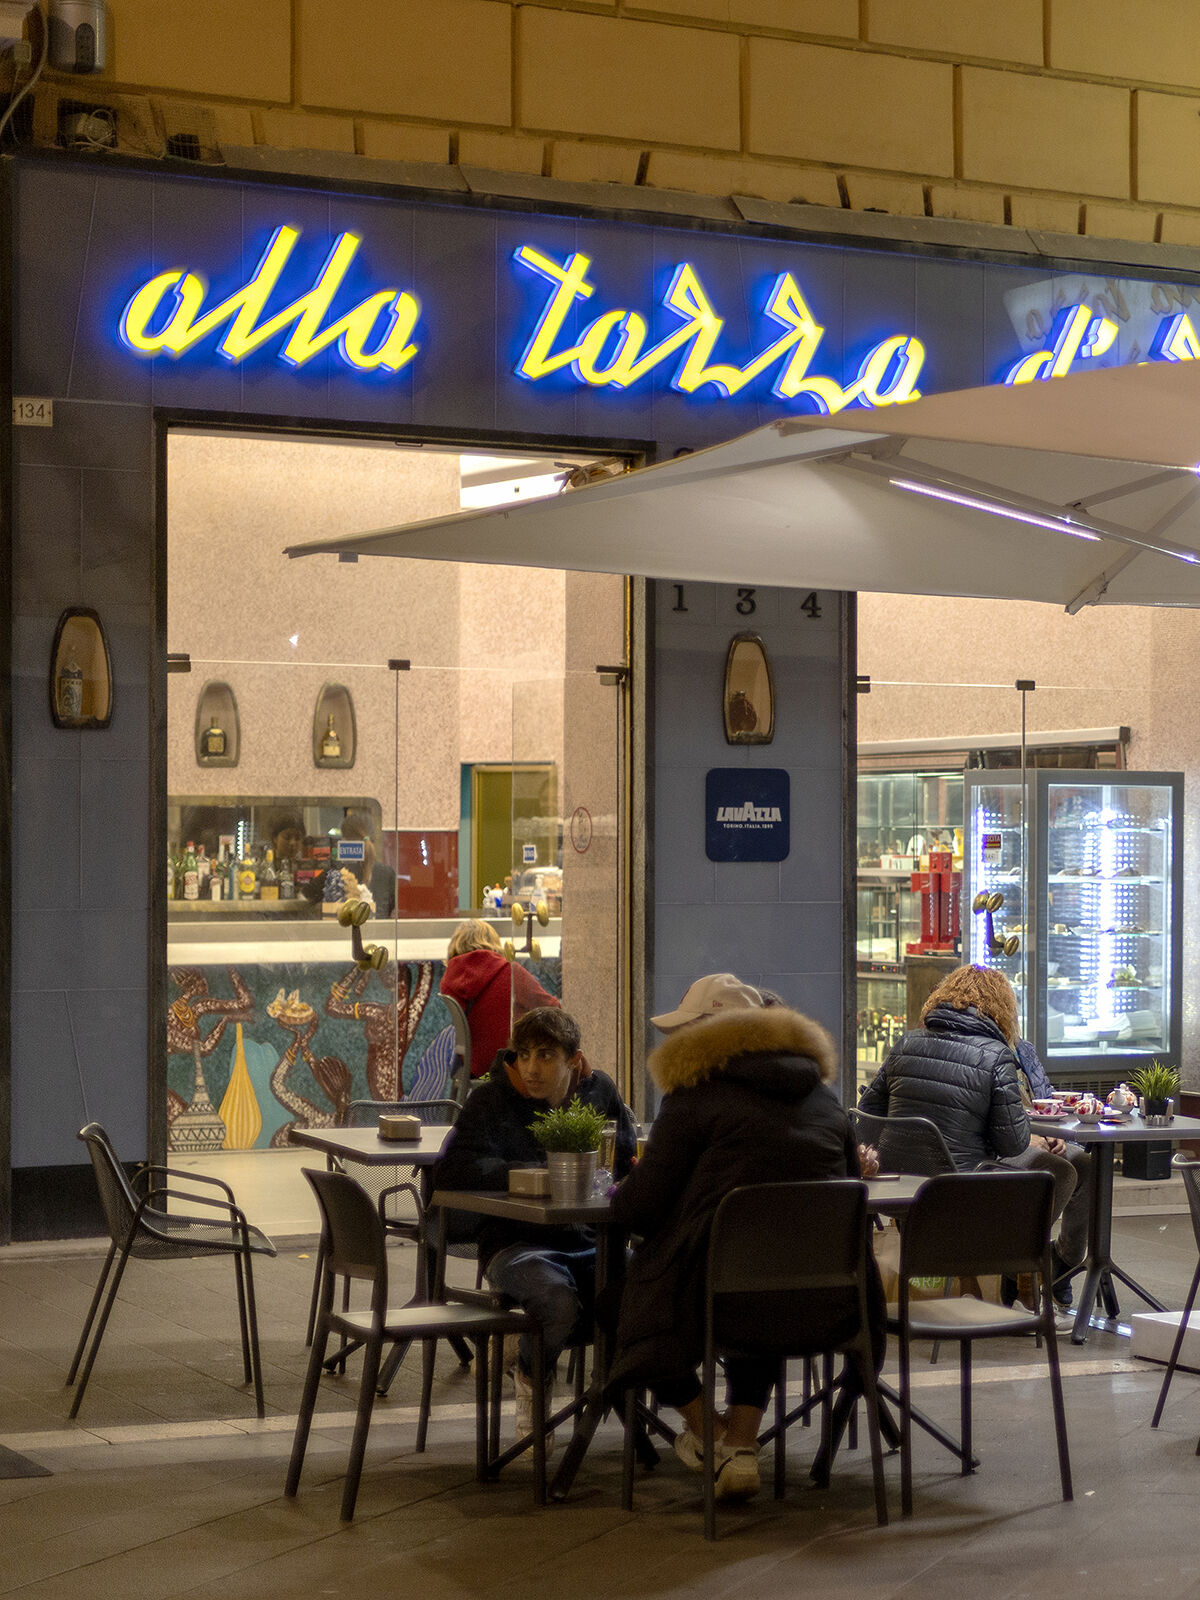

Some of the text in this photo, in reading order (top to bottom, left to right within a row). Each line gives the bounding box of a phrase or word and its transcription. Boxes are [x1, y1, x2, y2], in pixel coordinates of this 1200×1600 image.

[119, 225, 419, 371] alla
[513, 244, 927, 414] tazza
[19, 402, 45, 418] 134
[716, 801, 782, 822] LAVAZZA
